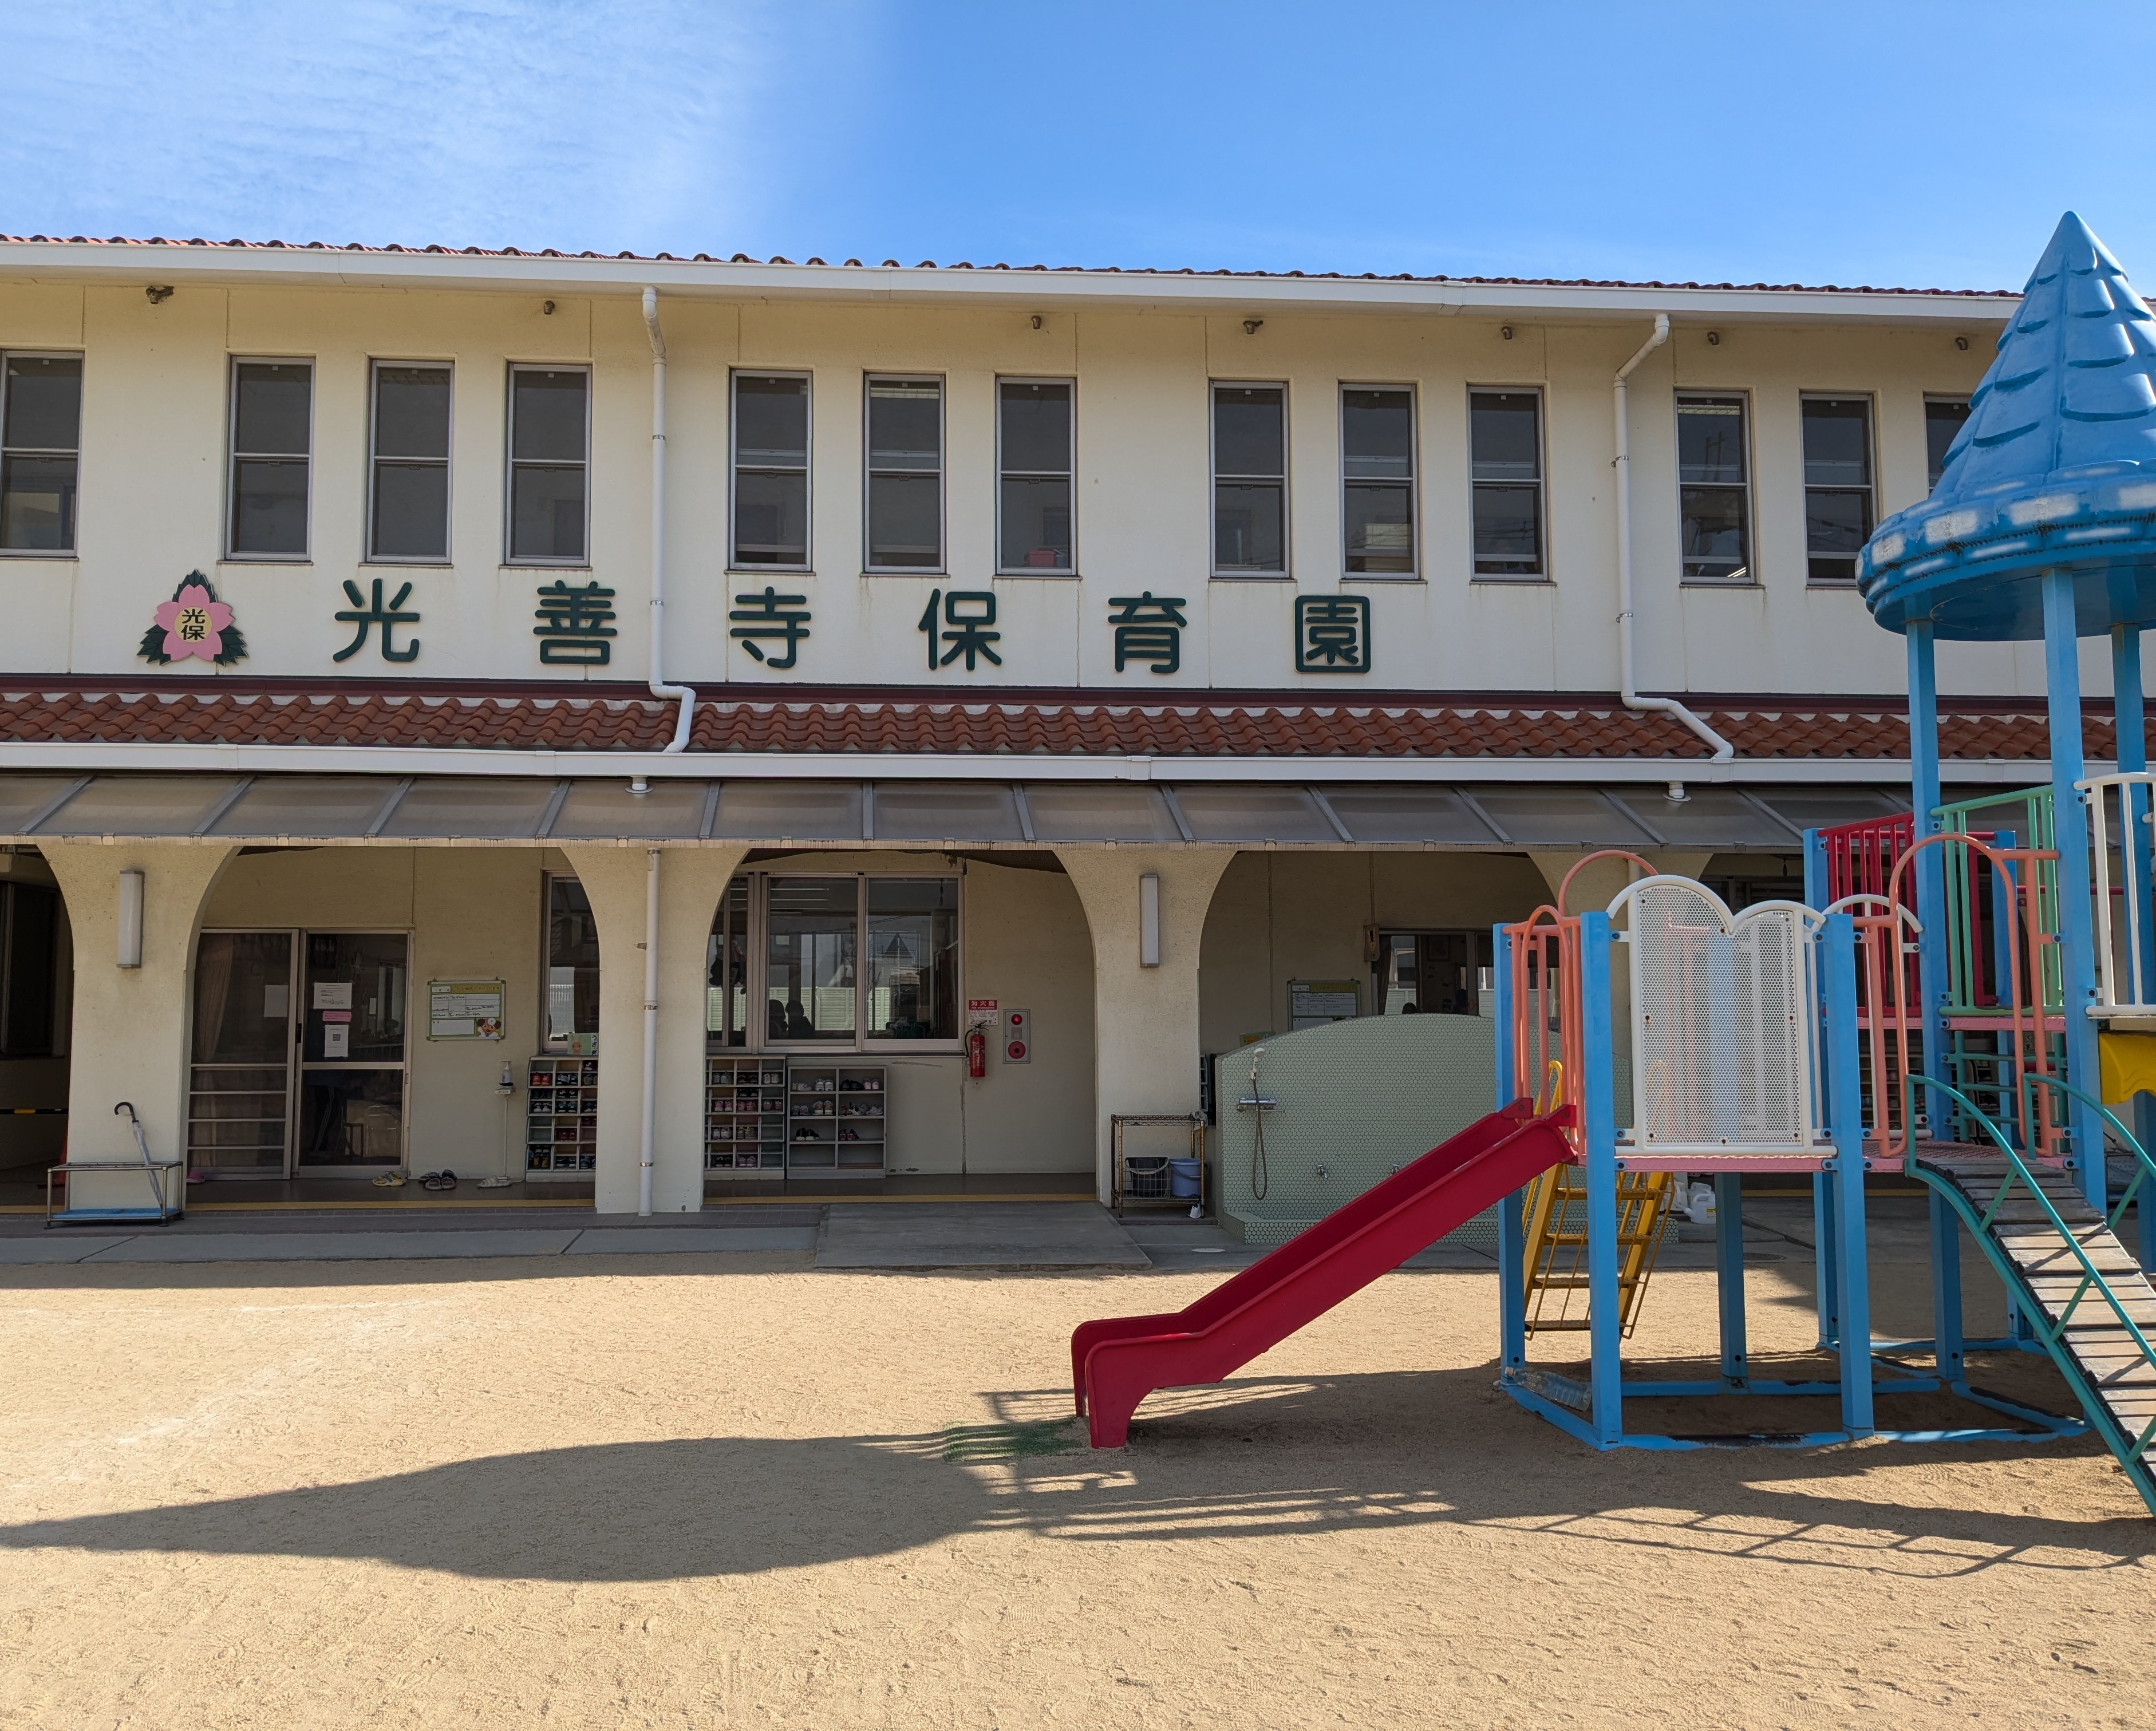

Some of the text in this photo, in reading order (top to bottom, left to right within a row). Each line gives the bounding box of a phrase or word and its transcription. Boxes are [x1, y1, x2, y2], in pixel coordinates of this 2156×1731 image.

[180, 608, 206, 641] 光保
[332, 578, 1372, 674] 光善寺保育園
